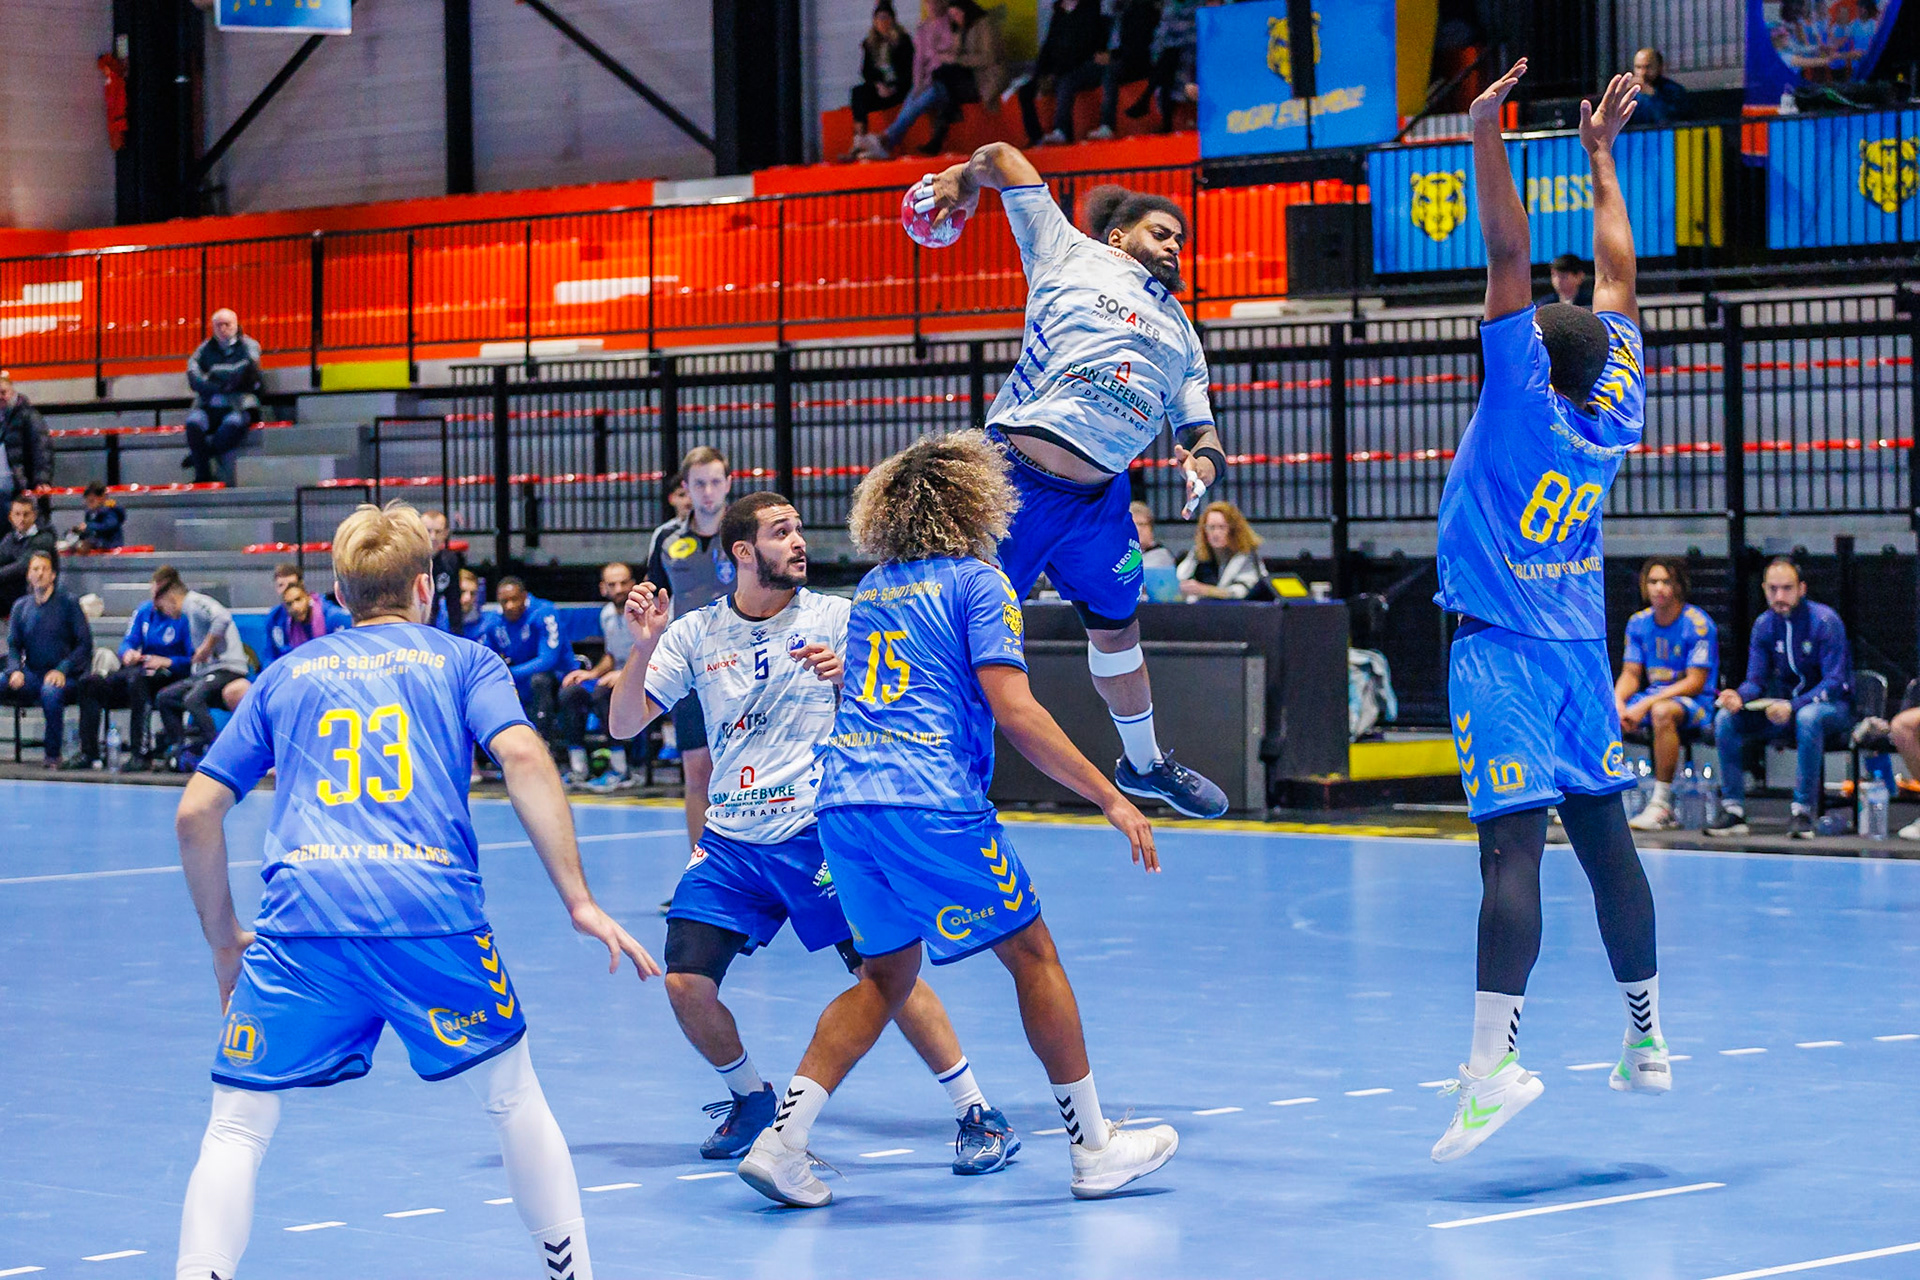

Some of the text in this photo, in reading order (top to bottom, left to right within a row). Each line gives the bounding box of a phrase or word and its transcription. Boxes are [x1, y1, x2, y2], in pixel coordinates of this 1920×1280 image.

[1095, 294, 1161, 342] SOCATEB
[1066, 363, 1100, 381] JEAN
[1101, 375, 1153, 417] LEFEBVRE
[1520, 470, 1602, 543] 88
[754, 648, 769, 680] 5
[856, 631, 910, 704] 15
[317, 703, 413, 806] 33
[731, 785, 796, 802] LEFEBVRE
[366, 843, 389, 860] EN
[392, 842, 451, 867] FRANCE
